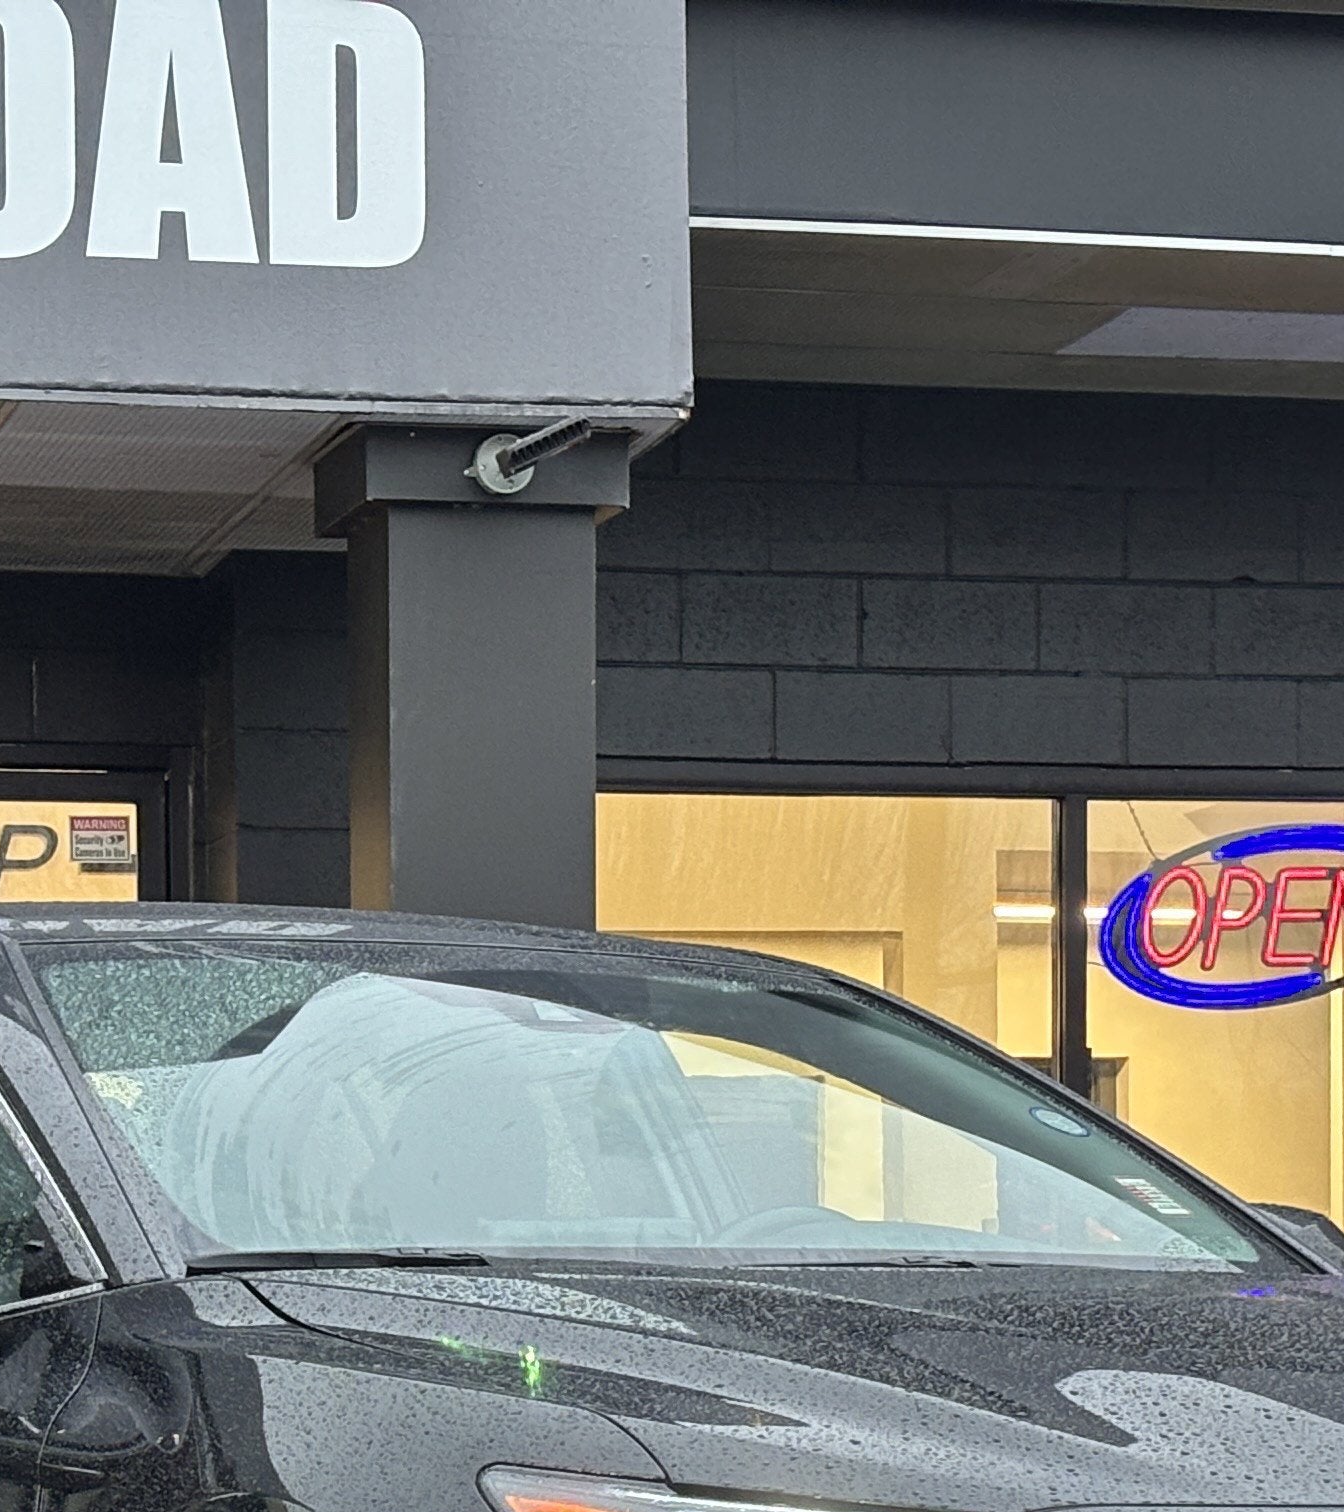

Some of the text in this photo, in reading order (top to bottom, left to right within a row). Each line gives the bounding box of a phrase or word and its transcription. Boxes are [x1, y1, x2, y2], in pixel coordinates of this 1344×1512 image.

[72, 818, 127, 830] WARNING
[74, 834, 104, 847] Security
[74, 847, 104, 858] Cameras
